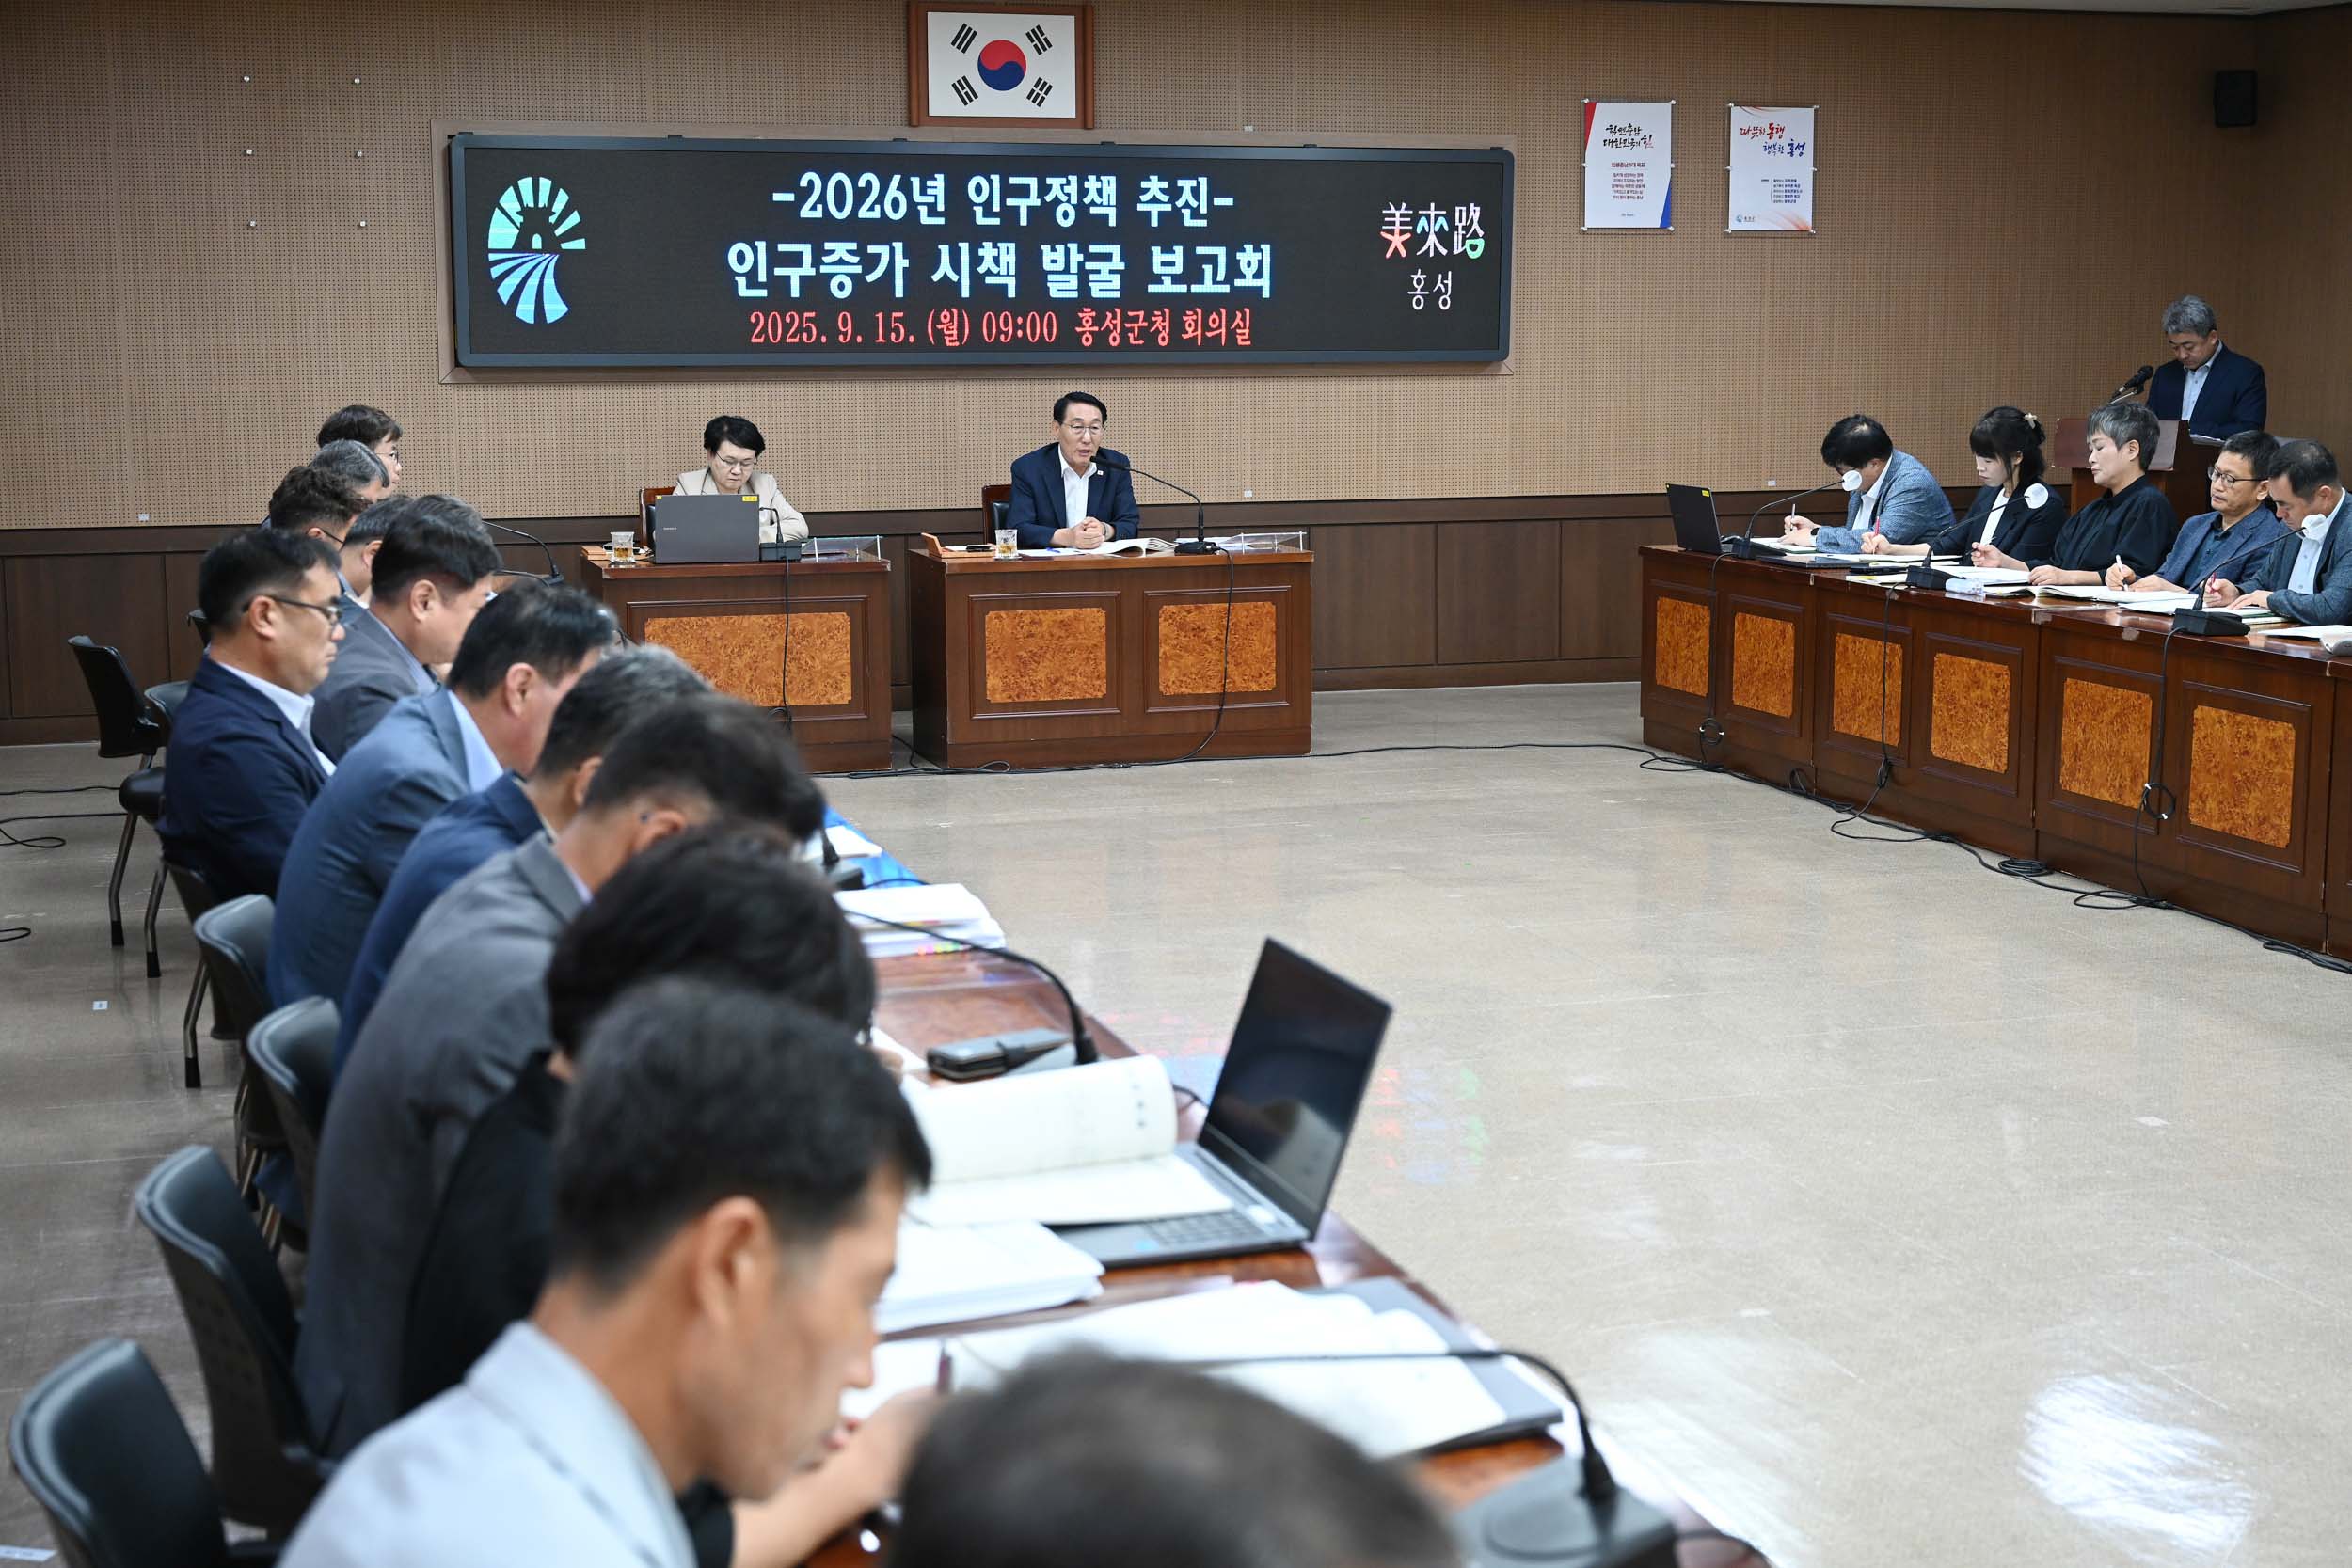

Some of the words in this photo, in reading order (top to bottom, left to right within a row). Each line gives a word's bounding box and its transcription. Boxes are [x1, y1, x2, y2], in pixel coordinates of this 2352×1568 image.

[1762, 142, 1785, 156] 행복한
[1787, 138, 1806, 158] 홍성
[1767, 122, 1785, 140] 동행
[772, 171, 946, 226] -2026년
[967, 173, 1117, 228] 인구정책
[1136, 174, 1234, 228] 추진-
[1379, 201, 1486, 260] 美來路
[727, 240, 910, 299] 인구증가
[930, 241, 1017, 299] 시책
[1040, 242, 1126, 299] 발굴
[1147, 244, 1271, 299] 보고회
[1407, 269, 1453, 310] 홍성
[750, 310, 827, 344] 2025.
[837, 311, 863, 343] 9.
[875, 311, 915, 343] 15.
[927, 308, 970, 347] (월)
[982, 310, 1057, 343] 09:00
[1074, 307, 1170, 347] 홍성군청
[1182, 307, 1251, 347] 회의실
